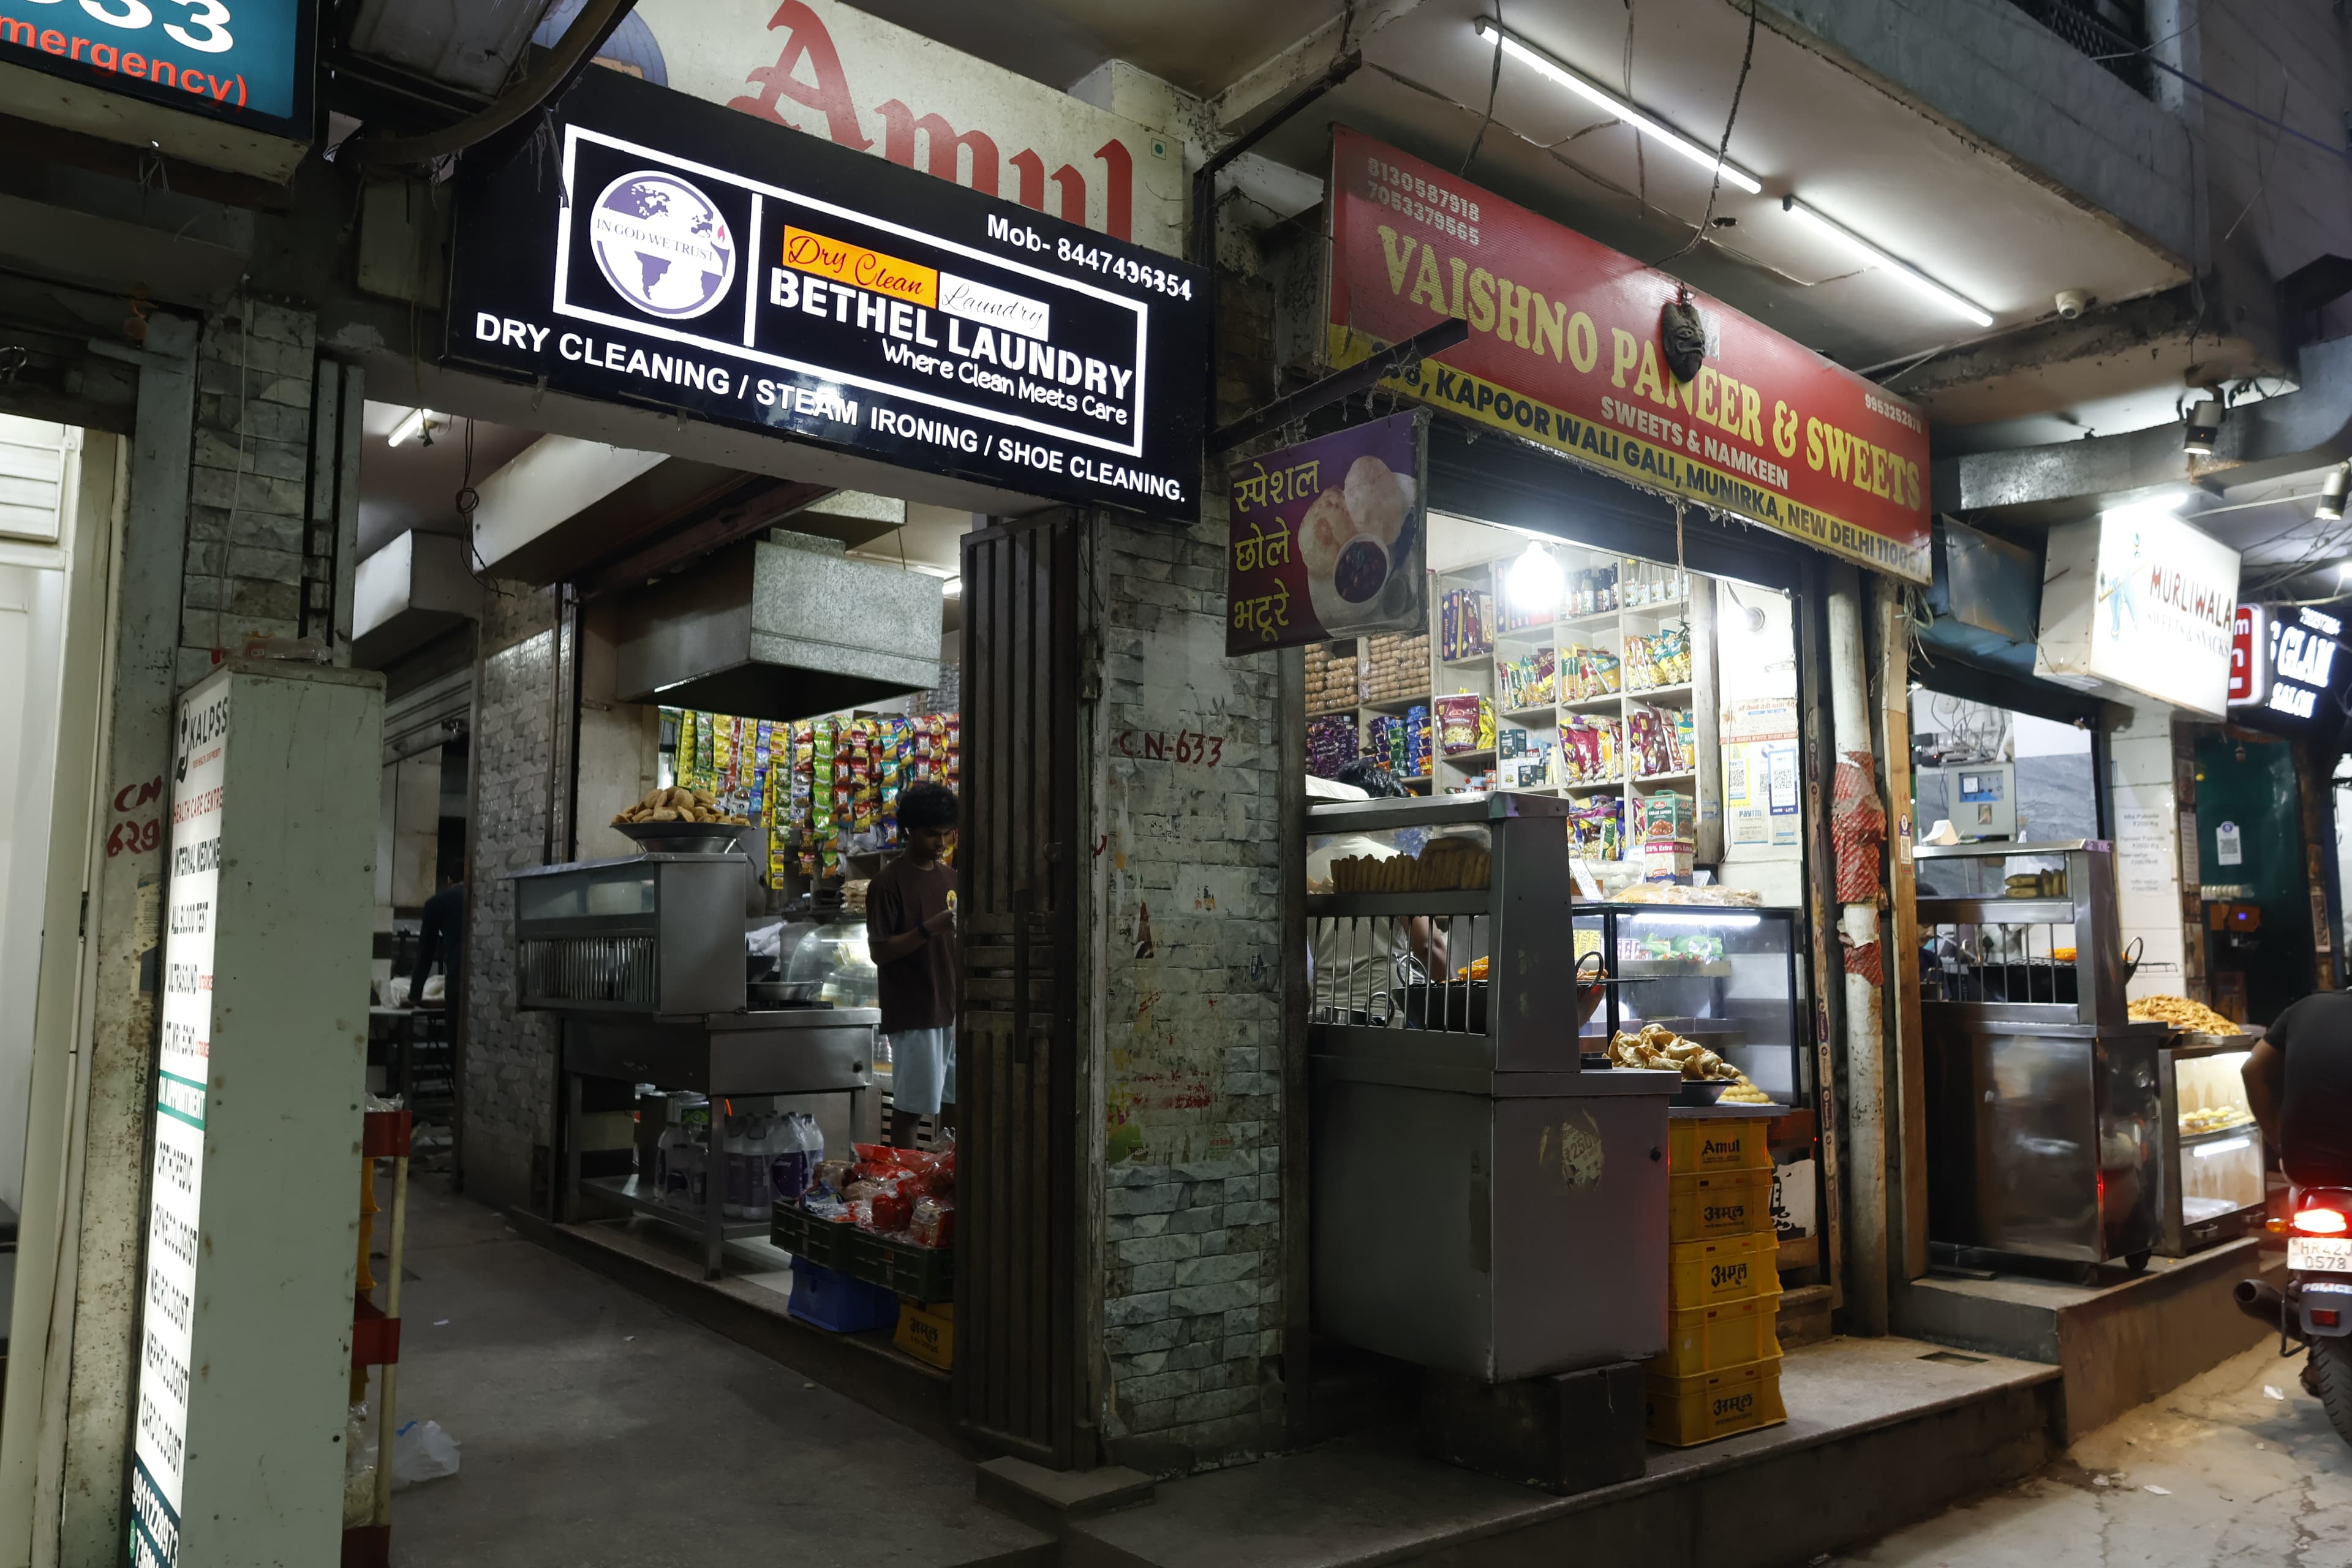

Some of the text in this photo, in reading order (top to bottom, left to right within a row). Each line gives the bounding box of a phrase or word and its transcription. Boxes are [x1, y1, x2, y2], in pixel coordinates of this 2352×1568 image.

[726, 0, 1133, 243] Amul
[1368, 157, 1479, 222] 8130587918
[596, 217, 717, 262] IN GOD WE TRUST
[787, 235, 924, 295] Dry Clean
[987, 214, 1192, 301] Mob- 8447496354
[770, 267, 1133, 399] BETHEL LAUNDRY
[941, 283, 1044, 330] Laundry
[882, 338, 1128, 425] Where Clean Meets Care
[1378, 225, 1597, 374] VAISHNO
[1773, 399, 1799, 458] &
[1805, 416, 1921, 511] SWEETS
[475, 312, 550, 352] DRY
[559, 333, 730, 395] CLEANING
[756, 379, 858, 425] STEAM
[871, 410, 979, 455] IRONING
[998, 438, 1064, 473] SHOE
[1070, 456, 1185, 502] CLEANING.
[1436, 368, 1550, 432] KAPOOR
[1555, 412, 1618, 460] WALI
[1623, 442, 1682, 488] GALI,
[1687, 463, 1784, 527] MUNIRKA,
[1788, 503, 1826, 538] NEW
[1831, 521, 1874, 557] DELHI
[1601, 396, 1789, 491] SWEETS & NAMKEEN
[1234, 461, 1321, 514] स्पेशल
[1235, 516, 1291, 572] छोले
[1234, 578, 1289, 642] भटूरे
[2150, 563, 2231, 632] MURLIWALA
[190, 696, 228, 750] KALPSS
[172, 786, 223, 824] HEALTH CARE CENTRE
[175, 837, 220, 877] INTERNAL MEDICINE
[180, 903, 195, 934] BLOOD
[196, 902, 208, 933] TEST
[168, 963, 197, 994] ULTRASOUND
[182, 1024, 195, 1057] ECHO
[157, 1075, 206, 1120] ON APPOINTMENT
[157, 1140, 193, 1194] ORTHOPEDIC
[1702, 1139, 1740, 1157] Amul
[154, 1202, 197, 1269] GYNECOLOGIST
[149, 1265, 189, 1335] NEUROLOGIST
[146, 1327, 189, 1409] NEPHROLOGIST
[141, 1392, 182, 1478] CARDIOLOGIST
[132, 1466, 179, 1568] 9911228973
